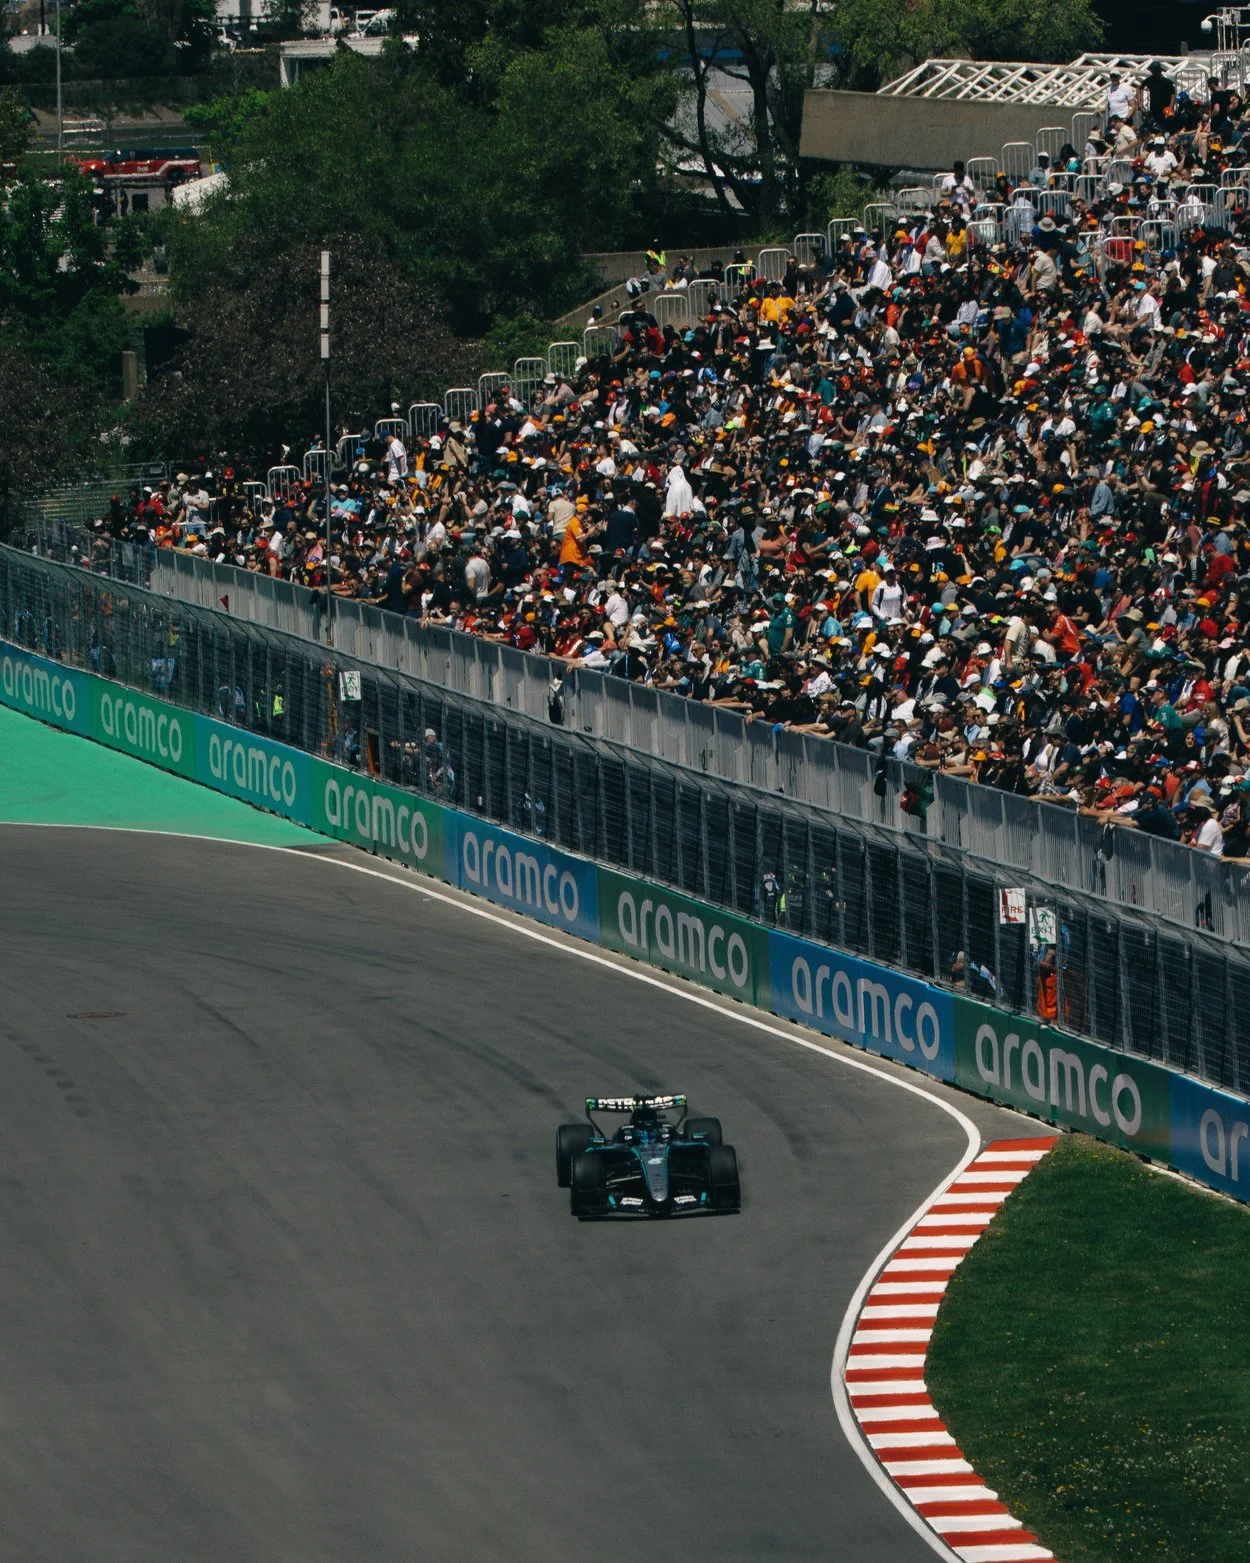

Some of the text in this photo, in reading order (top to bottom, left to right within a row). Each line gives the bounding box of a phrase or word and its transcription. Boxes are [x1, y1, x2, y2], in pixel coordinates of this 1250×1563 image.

[2, 656, 75, 720] aramco
[101, 693, 182, 762] aramco
[209, 734, 296, 806] aramco
[325, 779, 429, 861] aramco
[463, 832, 578, 922] aramco
[1002, 906, 1024, 914] FIRE
[618, 892, 748, 988] aramco
[792, 957, 939, 1061] aramco
[975, 1024, 1141, 1136] aramco
